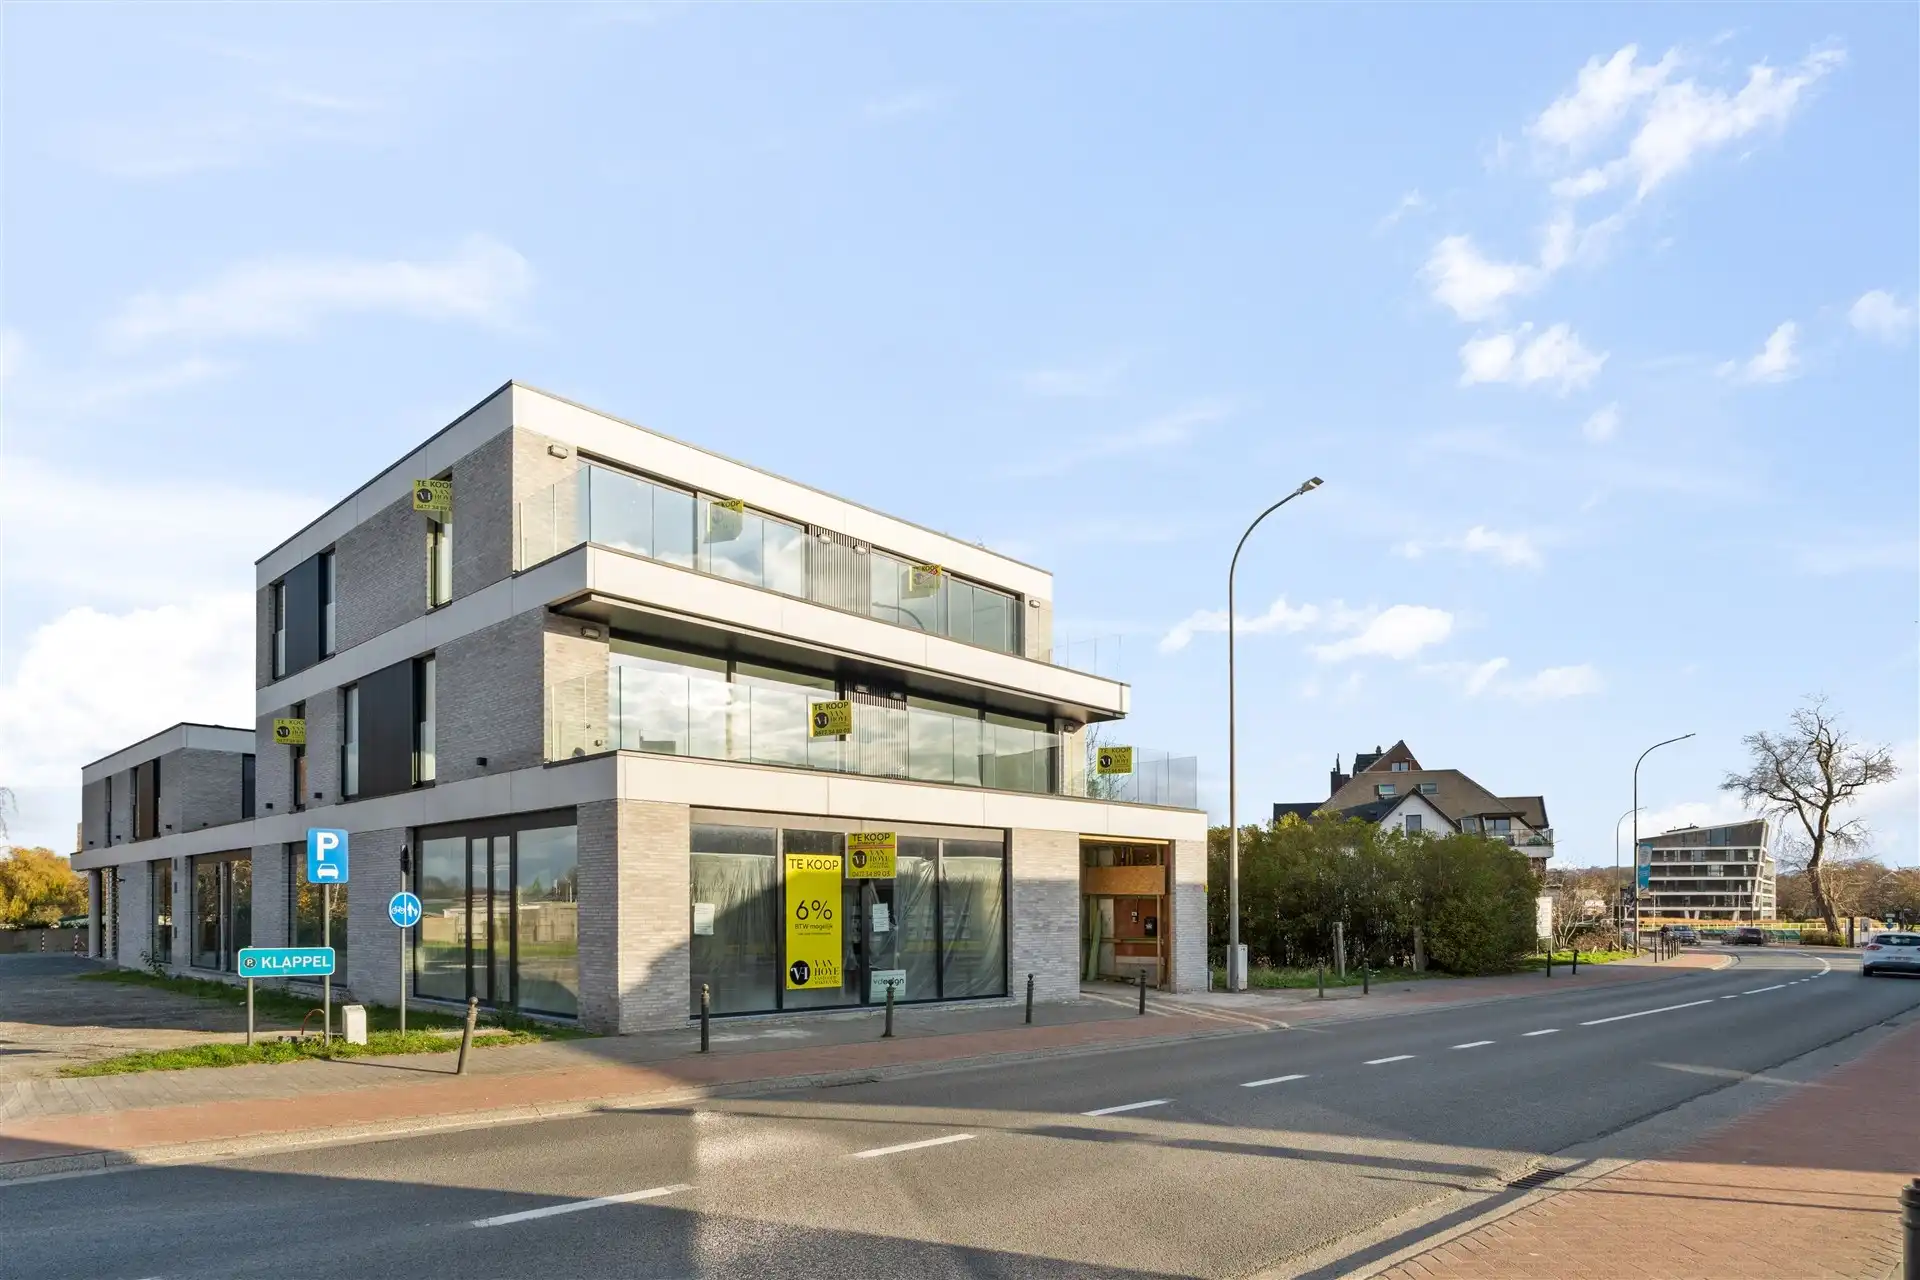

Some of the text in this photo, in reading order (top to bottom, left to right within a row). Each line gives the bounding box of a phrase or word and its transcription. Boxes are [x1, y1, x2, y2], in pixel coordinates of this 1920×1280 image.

[721, 500, 741, 508] KOOP
[826, 702, 849, 710] KOOP
[851, 833, 891, 842] TE KOOP
[317, 832, 339, 861] P
[789, 858, 839, 870] TE KOOP
[796, 900, 833, 920] 6%
[261, 956, 331, 968] KLAPPEL
[814, 959, 833, 967] VAN
[814, 967, 840, 976] HOYE
[873, 976, 904, 986] vdegn
